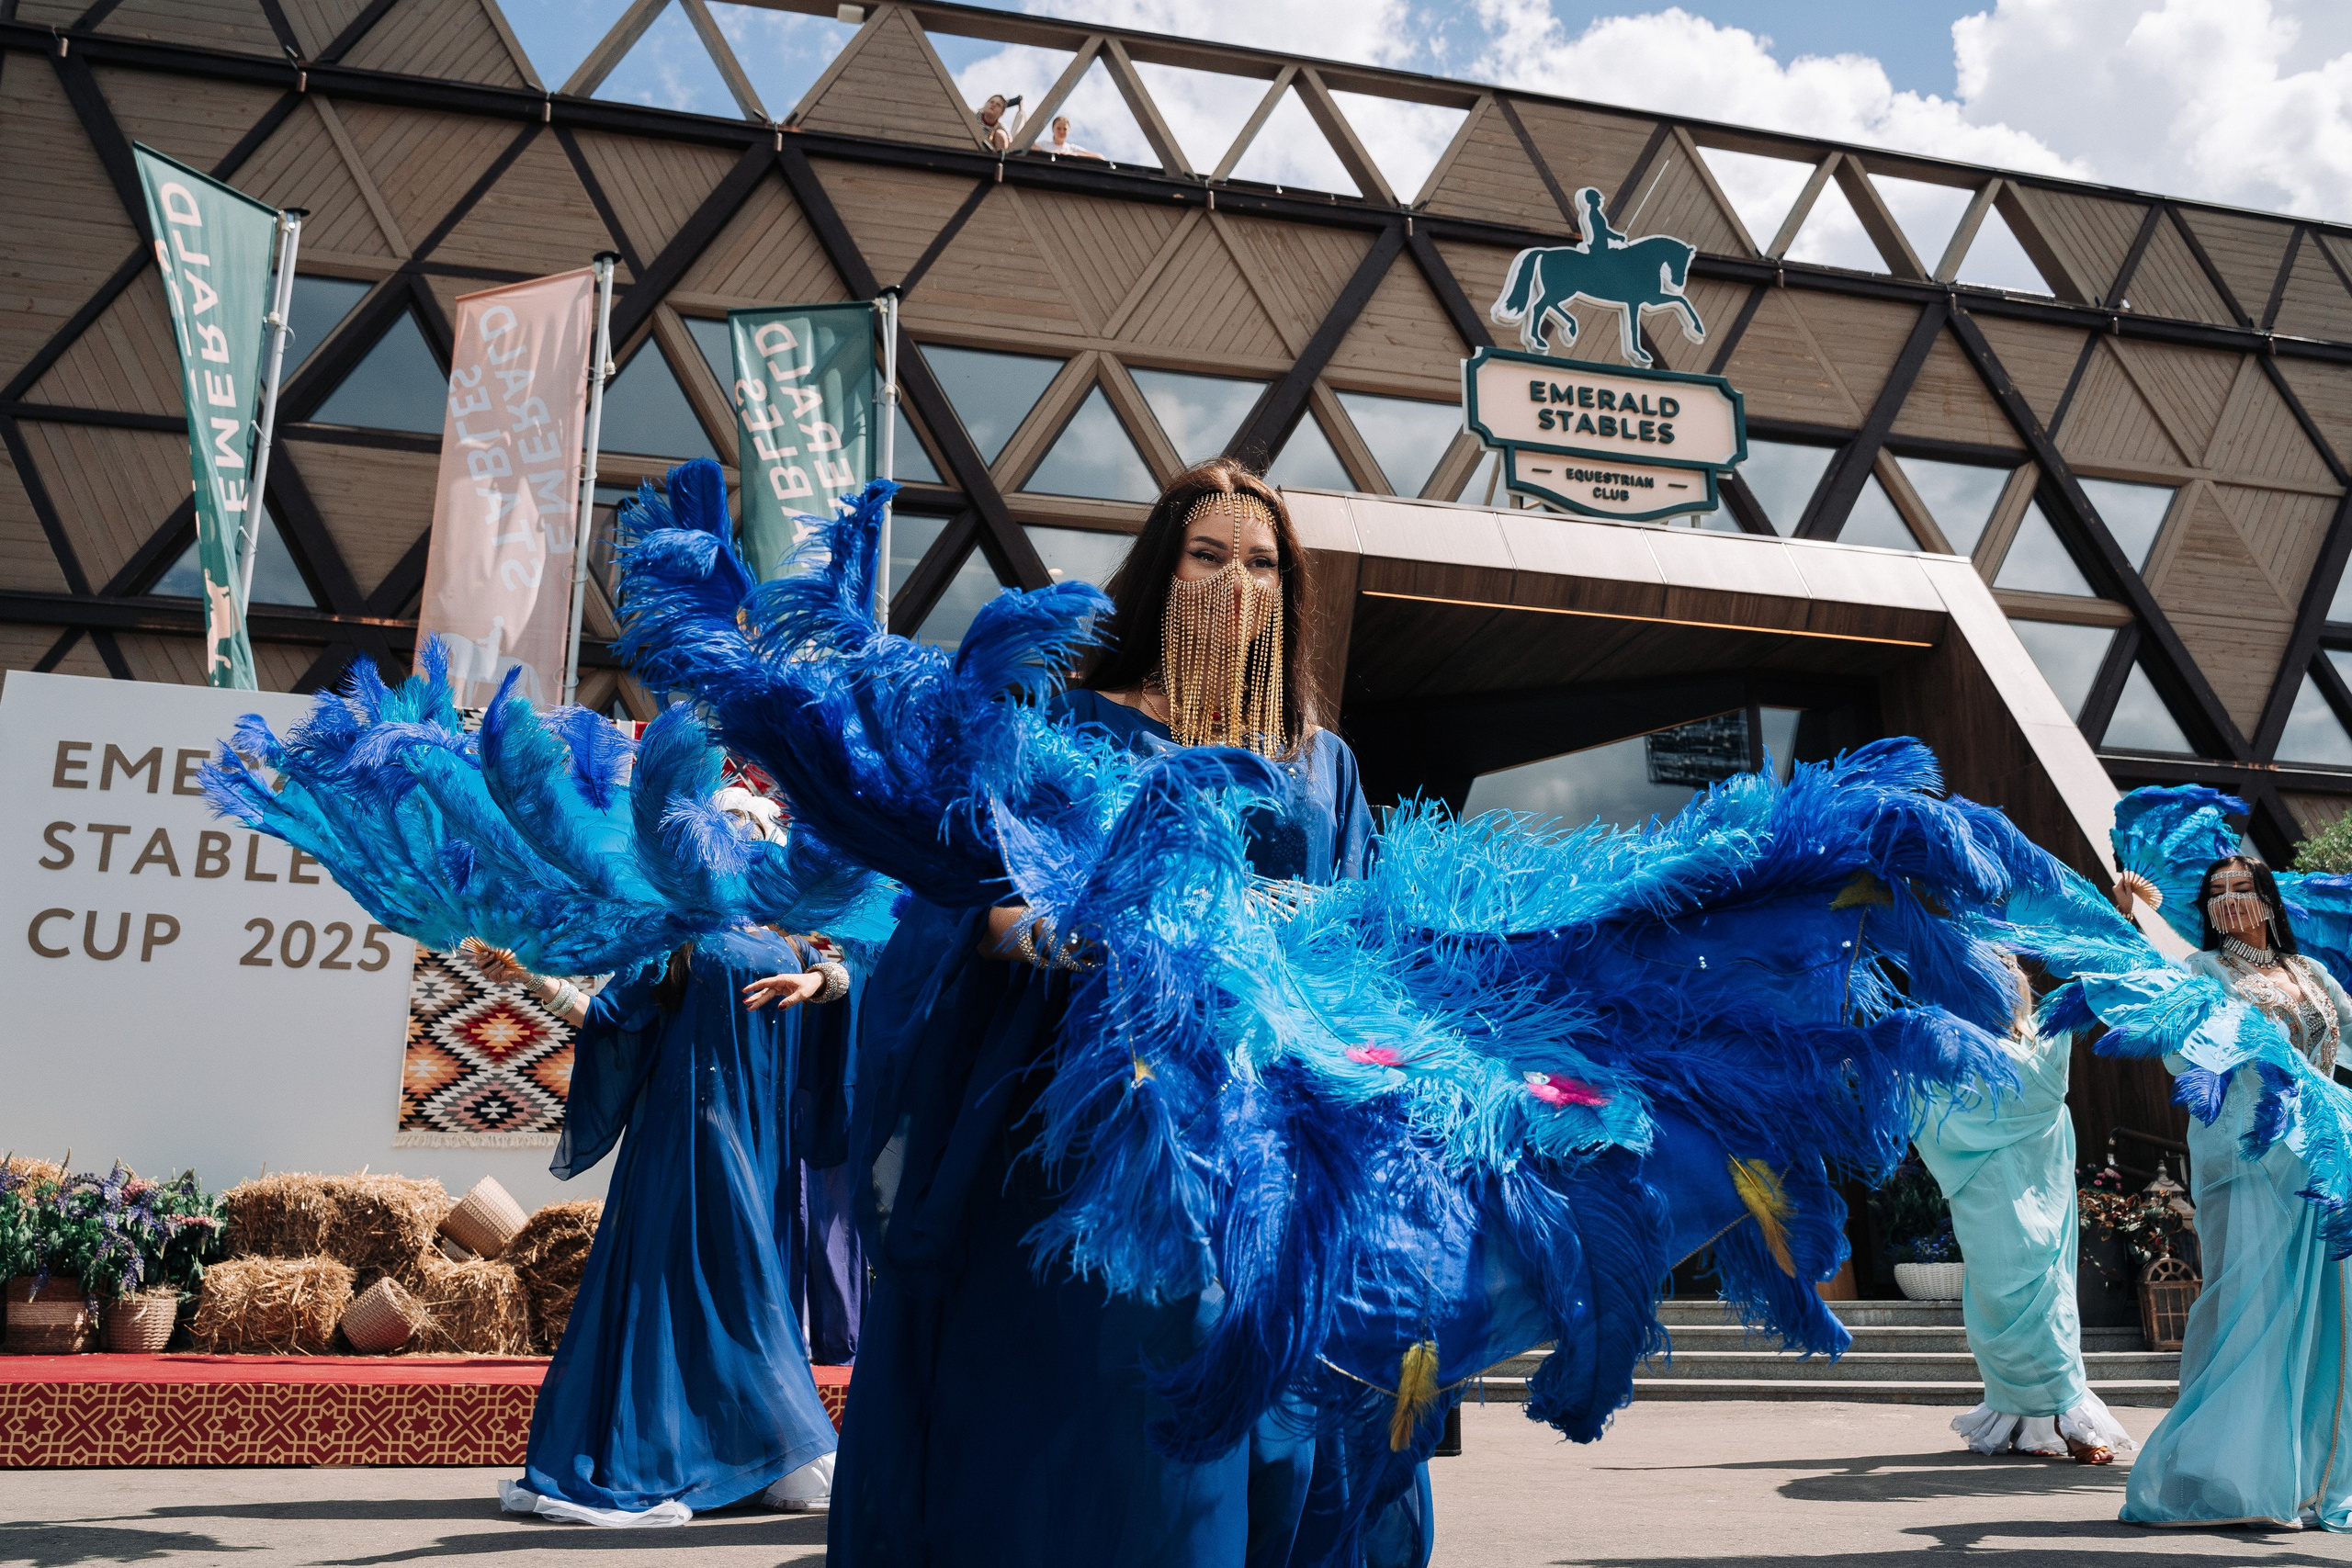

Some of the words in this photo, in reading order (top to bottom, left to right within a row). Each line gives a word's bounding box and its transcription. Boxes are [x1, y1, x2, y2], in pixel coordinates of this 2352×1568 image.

[1530, 380, 1680, 418] EMERALD
[1538, 408, 1675, 445] STABLES
[1566, 468, 1654, 488] EQUESTRIAN
[1592, 487, 1629, 501] CLUB
[39, 821, 337, 885] STABLE
[28, 908, 181, 963] CUP
[239, 917, 392, 972] 2025
